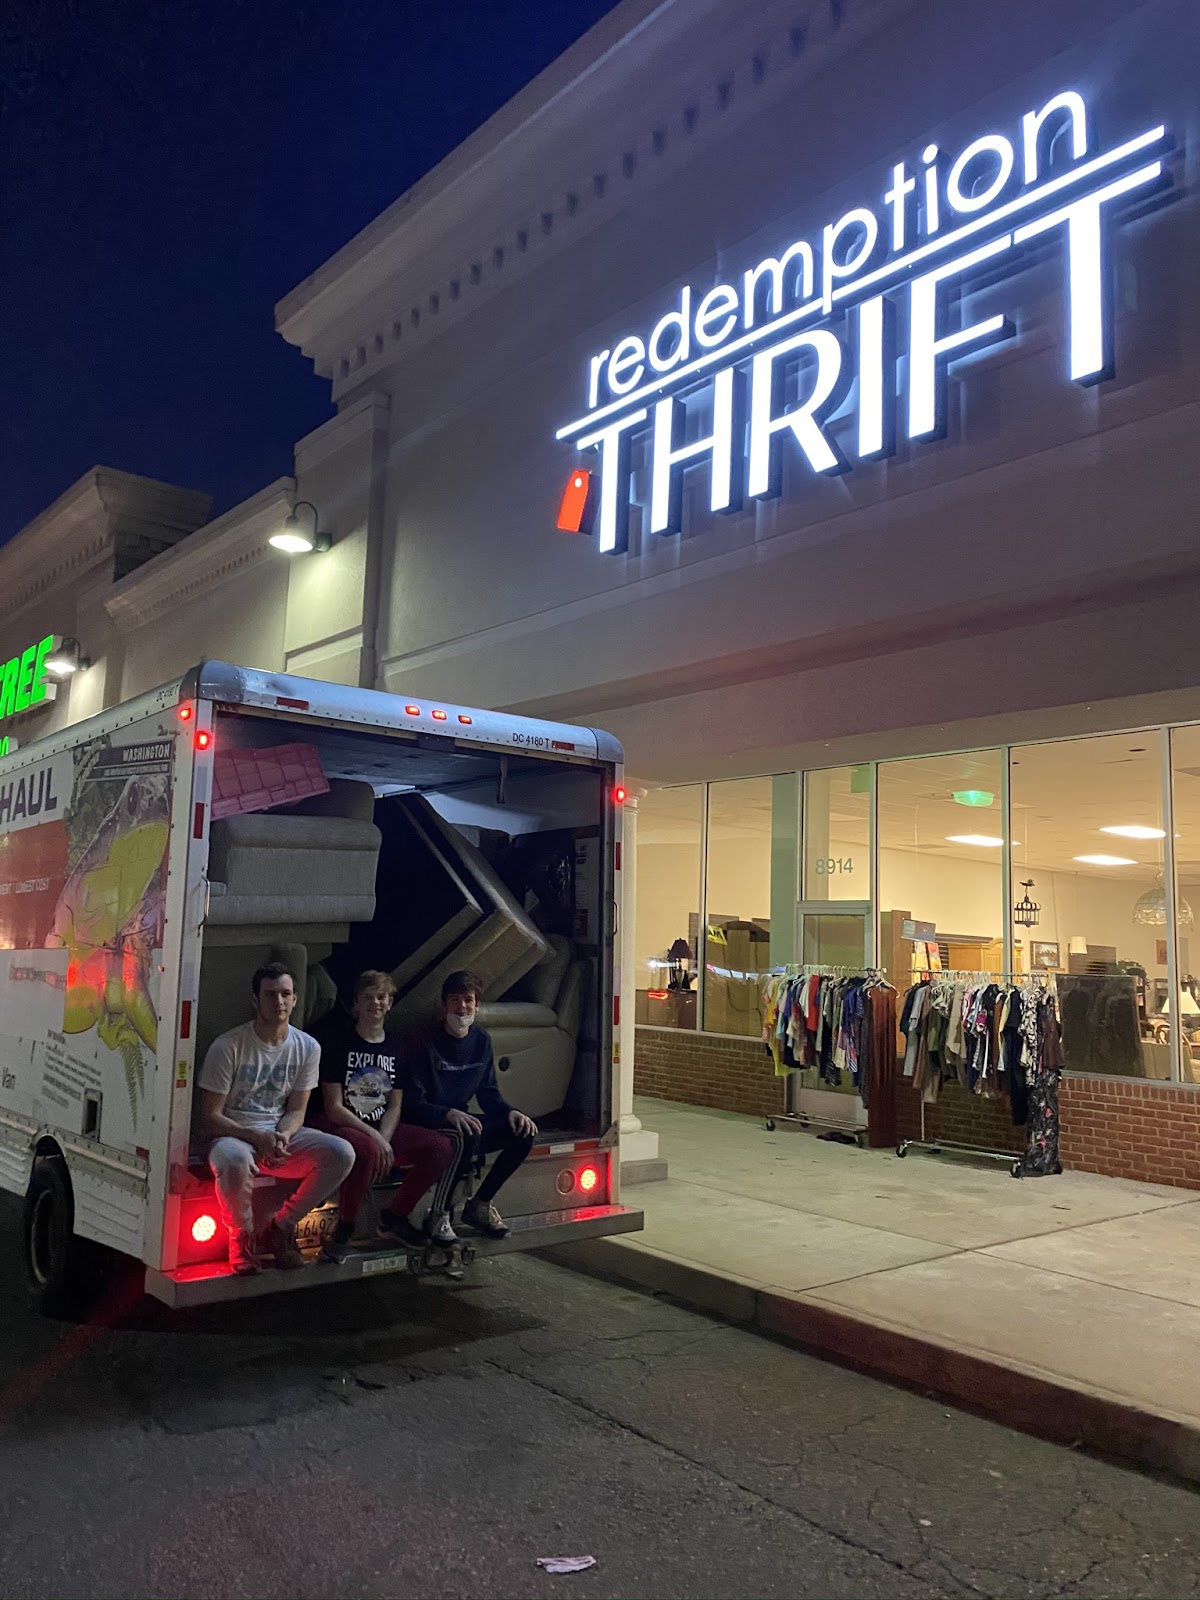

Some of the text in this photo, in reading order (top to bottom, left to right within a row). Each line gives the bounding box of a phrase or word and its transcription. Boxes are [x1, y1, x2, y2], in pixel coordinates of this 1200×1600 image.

[588, 90, 1088, 408] redemption
[576, 160, 1162, 554] THRIFT
[122, 743, 171, 762] WASHINGTON
[512, 732, 550, 749] DC 4180 T
[0, 767, 58, 824] HAUL
[815, 857, 854, 875] 8914
